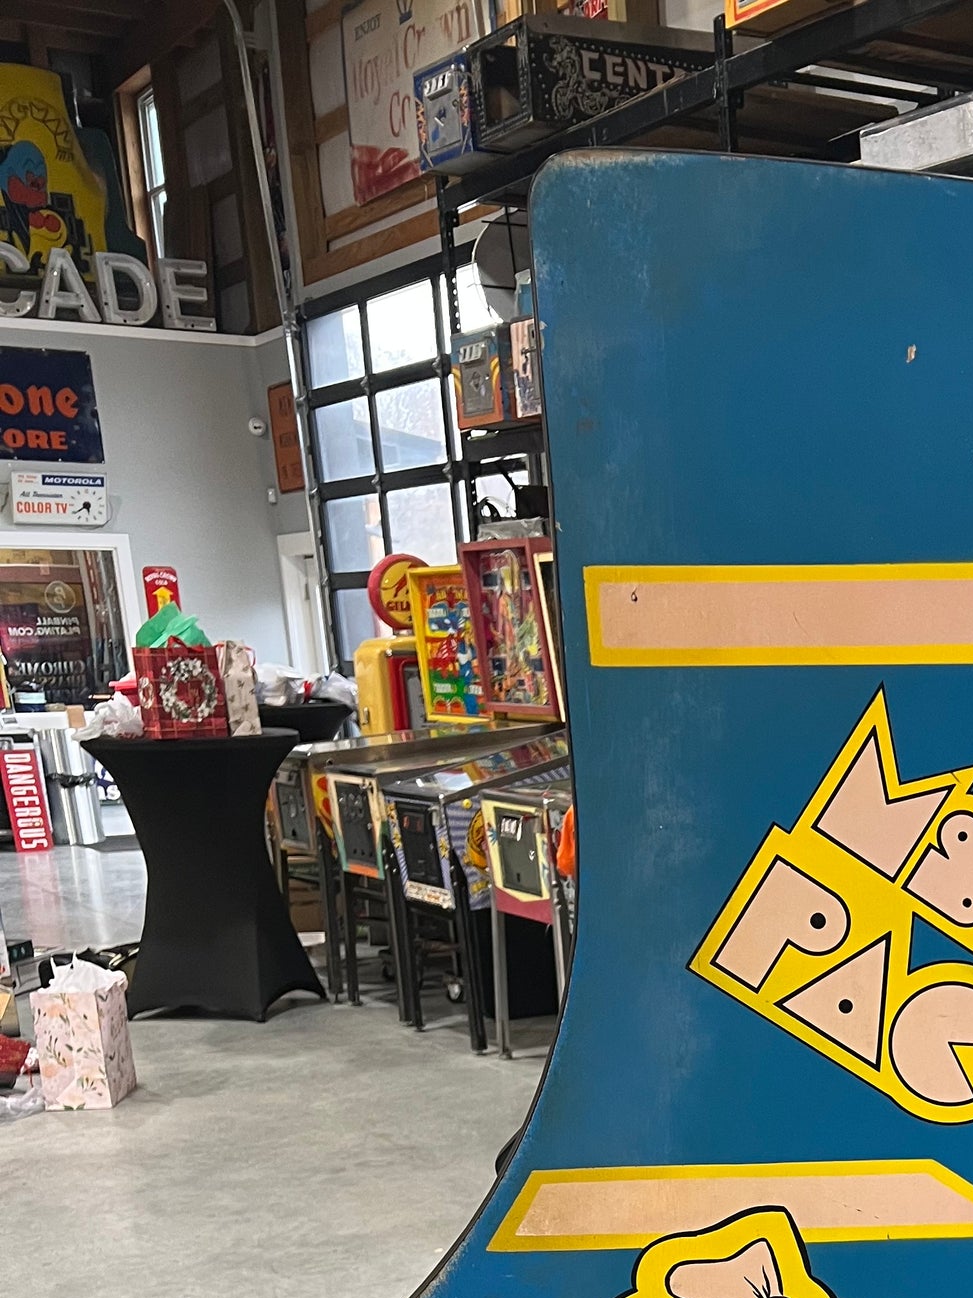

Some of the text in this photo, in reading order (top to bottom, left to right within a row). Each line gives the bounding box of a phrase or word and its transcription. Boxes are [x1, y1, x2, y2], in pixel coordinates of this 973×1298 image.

[354, 13, 382, 41] ENJOY
[0, 383, 79, 419] one
[44, 476, 102, 486] MOTOROLA
[16, 501, 68, 514] COLOR TV
[3, 752, 49, 850] DANGEROUS
